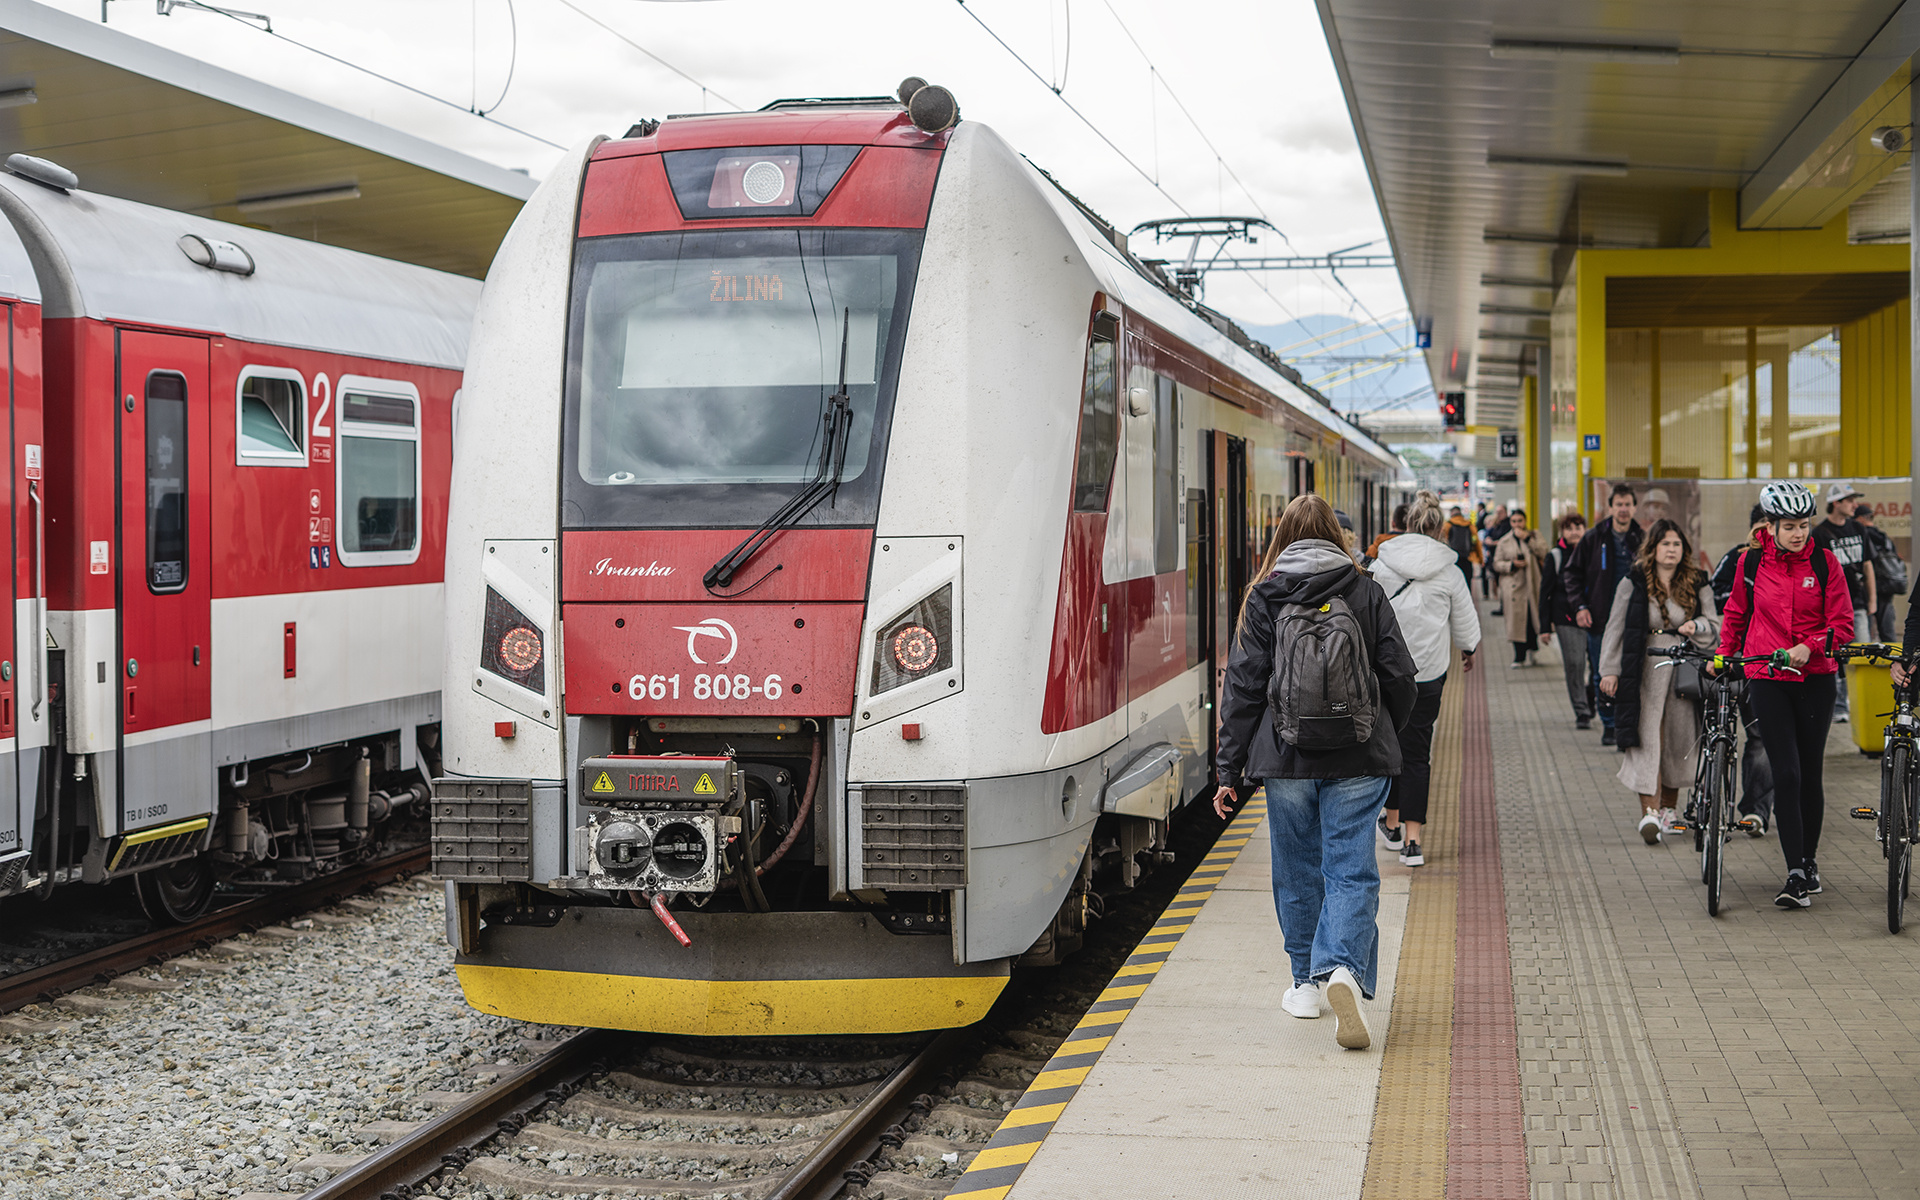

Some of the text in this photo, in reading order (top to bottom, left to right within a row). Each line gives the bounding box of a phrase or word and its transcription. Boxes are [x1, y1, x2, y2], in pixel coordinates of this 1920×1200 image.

[709, 270, 784, 302] ŽILINA
[312, 371, 331, 438] 2
[628, 673, 783, 701] 661 808-6
[126, 809, 136, 822] TB
[147, 803, 168, 818] SSOD
